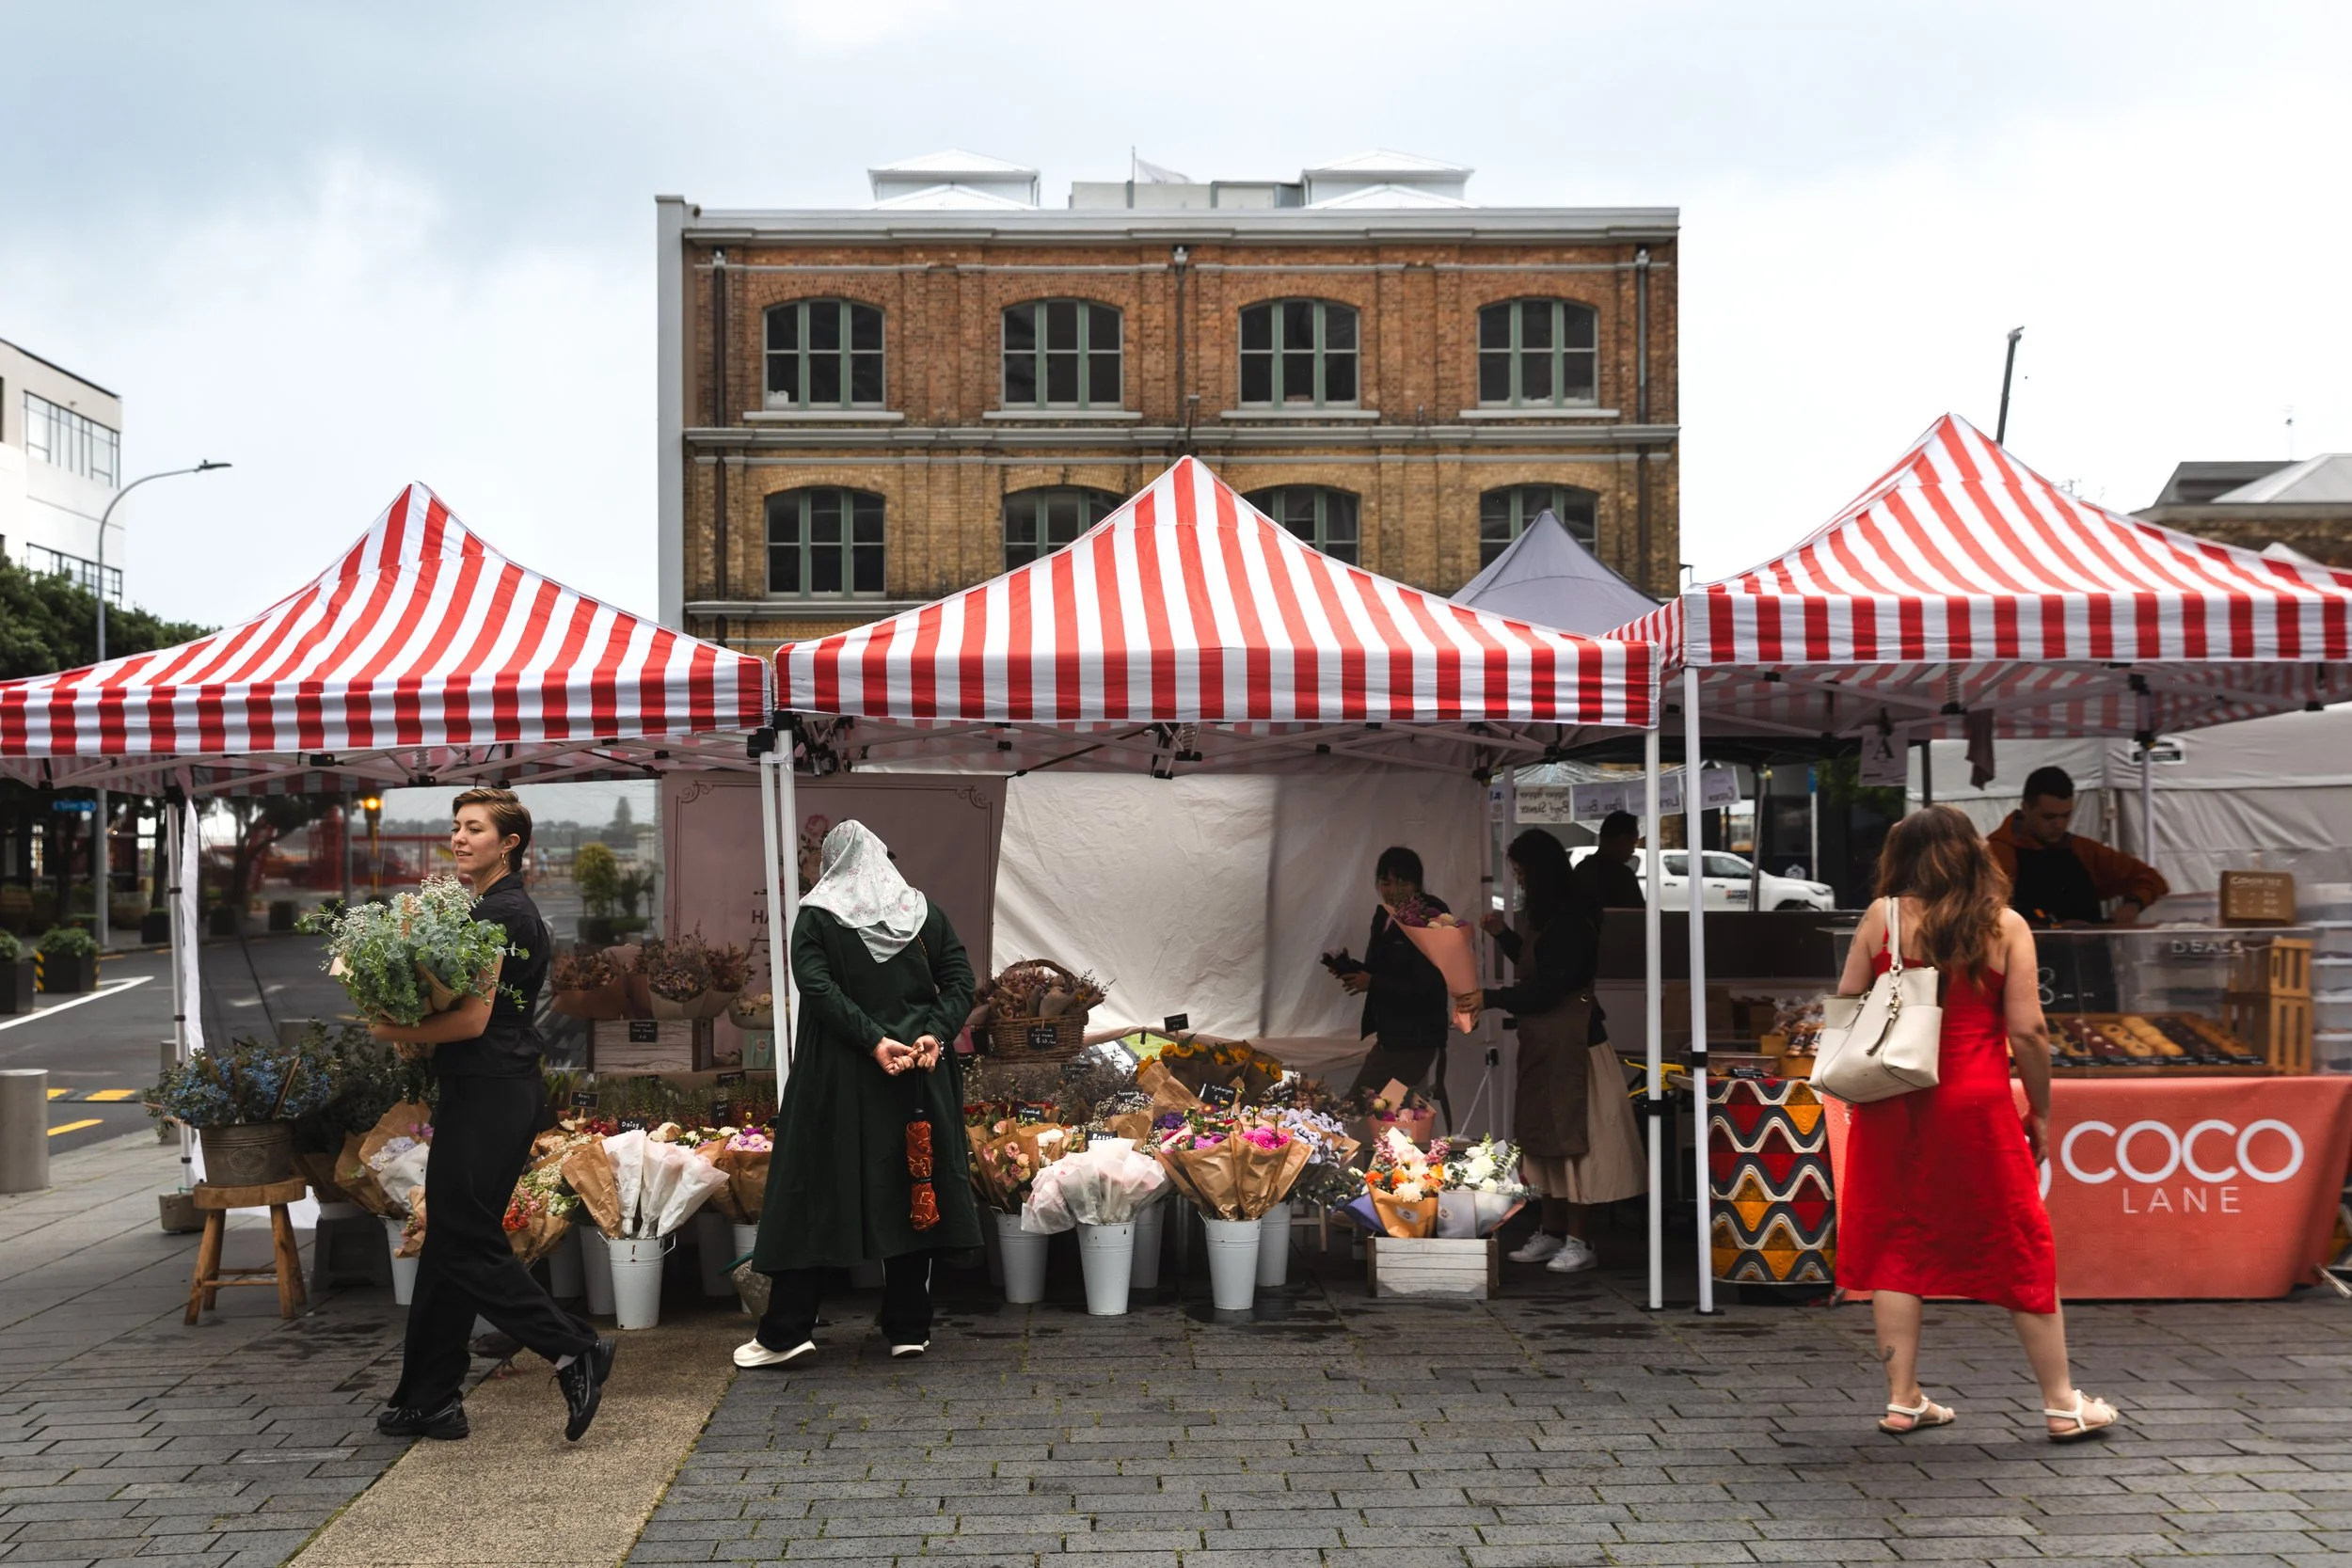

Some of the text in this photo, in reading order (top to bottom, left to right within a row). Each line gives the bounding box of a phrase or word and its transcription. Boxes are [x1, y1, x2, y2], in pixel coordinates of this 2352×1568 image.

[2170, 940, 2245, 954] DEALS
[621, 1121, 640, 1130] Daisy
[2060, 1118, 2304, 1183] COCO
[2122, 1186, 2242, 1213] LANE
